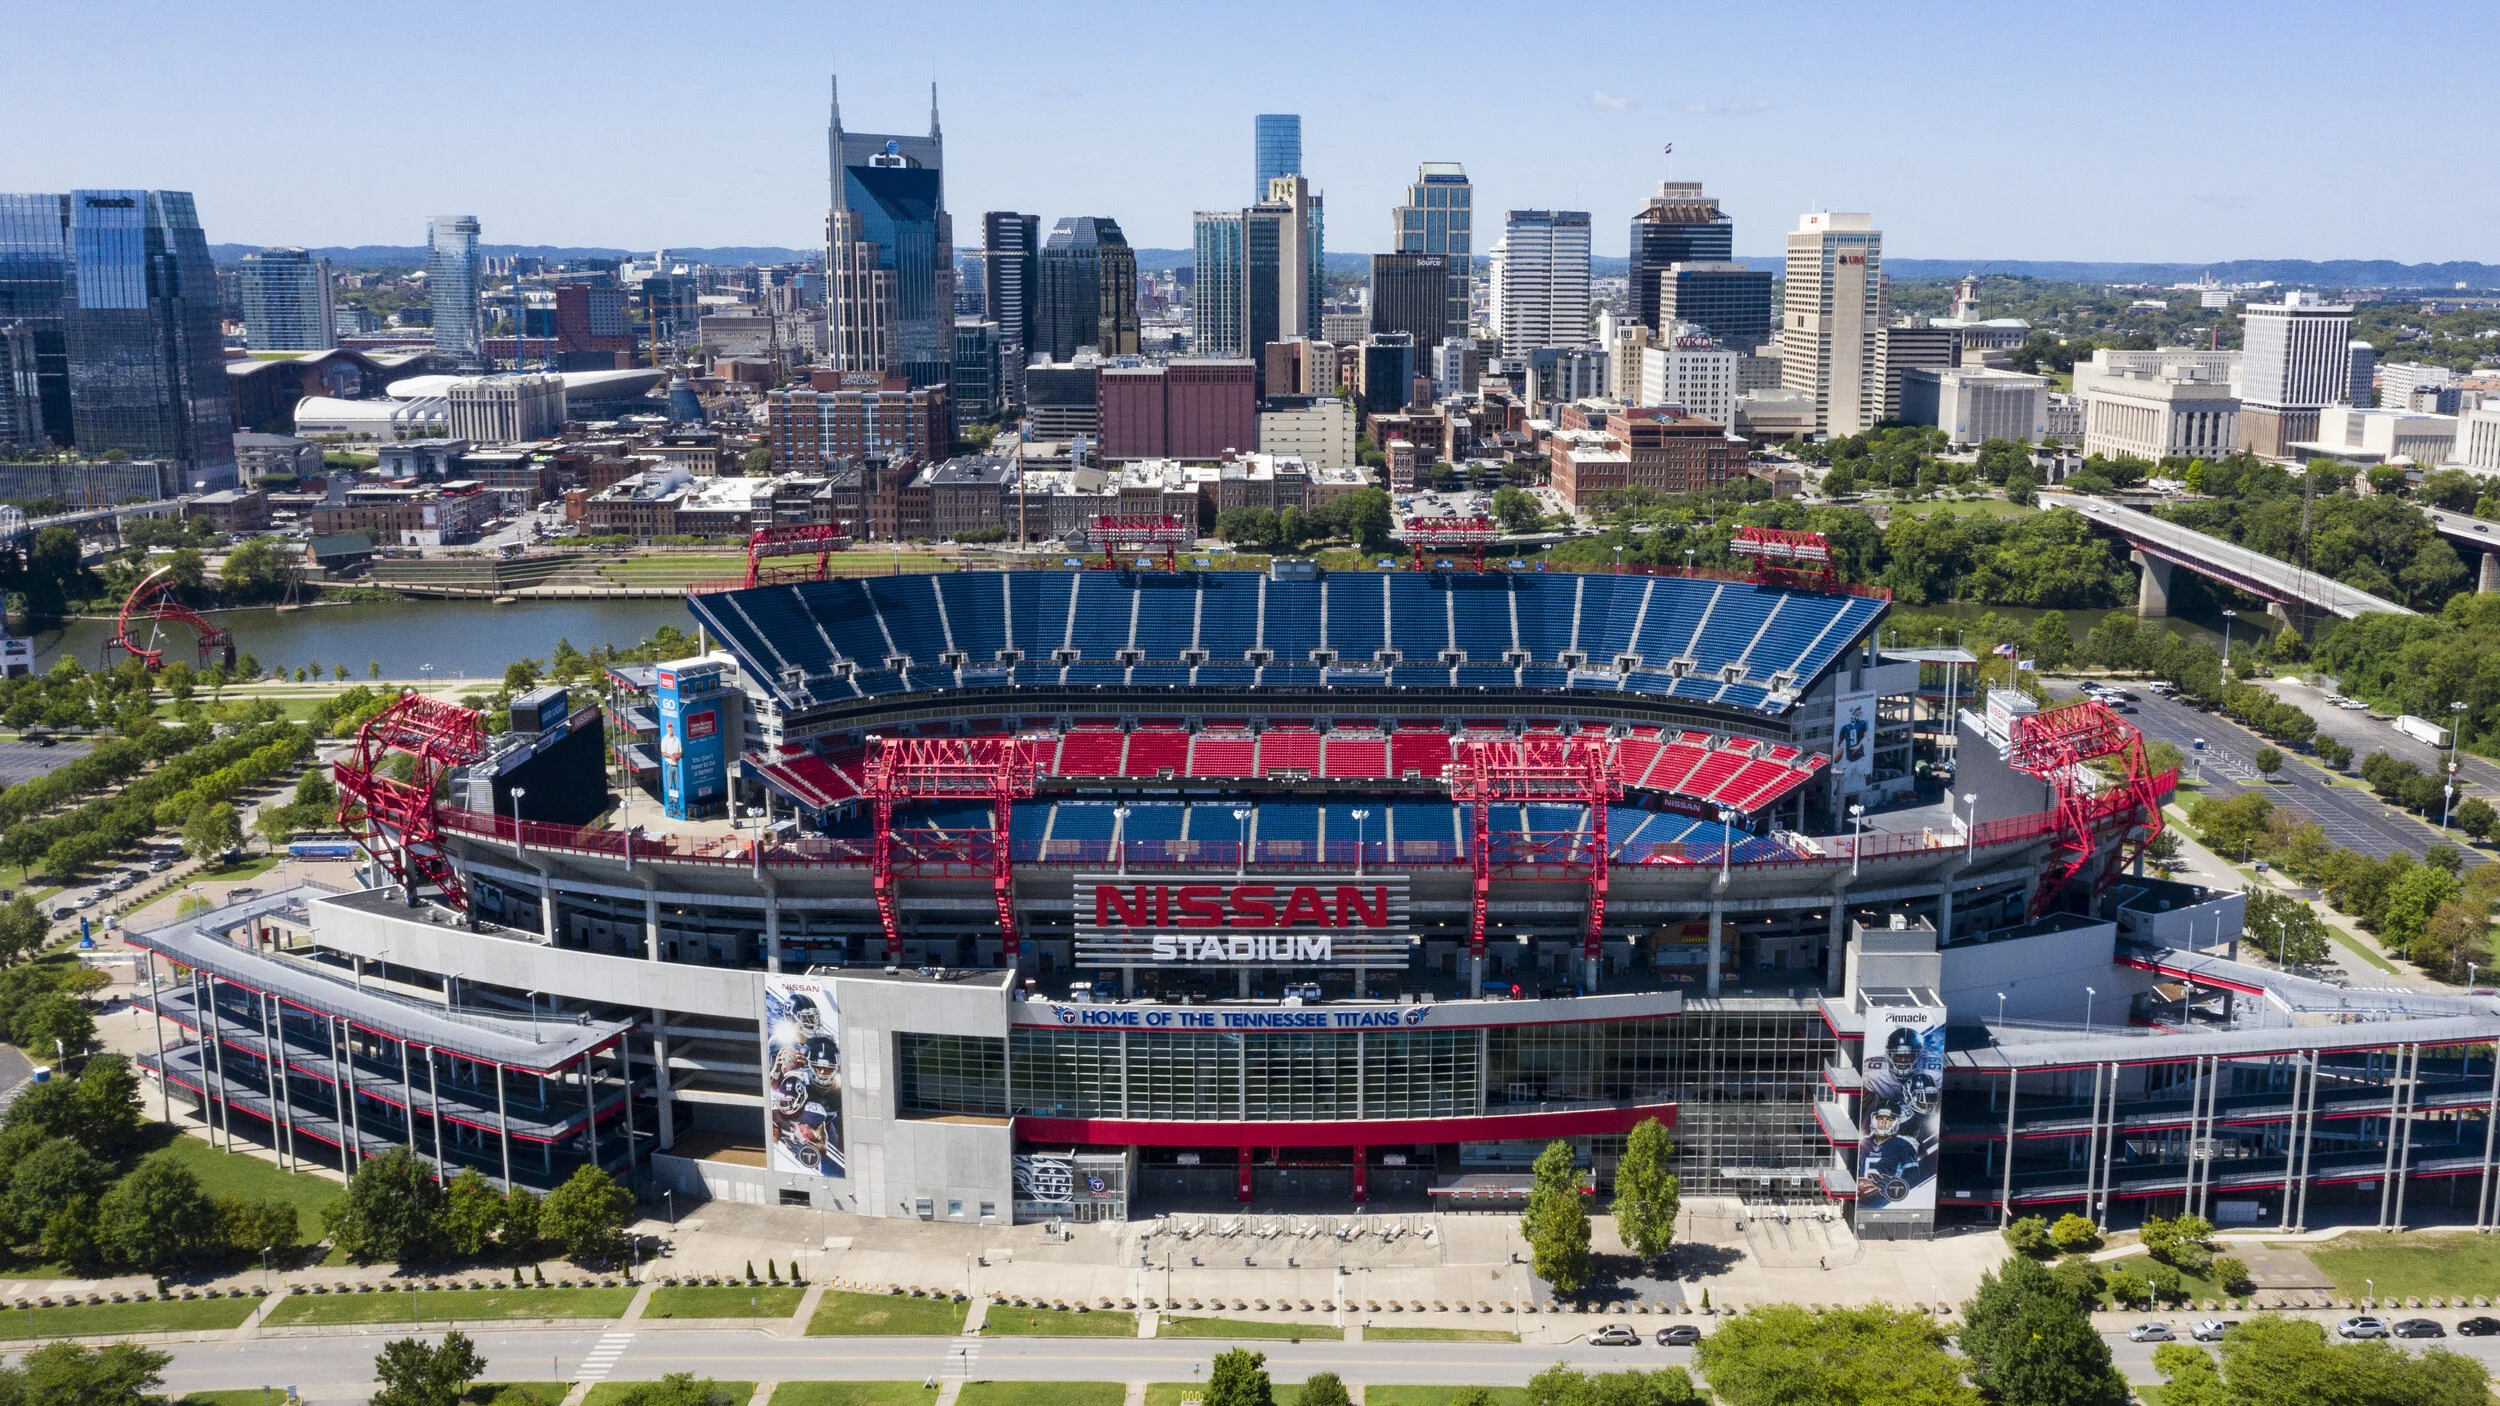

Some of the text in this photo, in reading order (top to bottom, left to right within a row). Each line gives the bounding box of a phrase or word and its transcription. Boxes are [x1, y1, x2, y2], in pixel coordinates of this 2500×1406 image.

[1848, 255, 1865, 265] UBS
[663, 698, 676, 710] GO
[1664, 798, 1701, 812] NISSAN
[1096, 886, 1387, 927] NISSAN
[1152, 936, 1331, 961] STADIUM
[781, 983, 820, 993] NISSAN
[1082, 1011, 1399, 1027] HOME OF THE TENNESSEE TITANS
[1885, 1012, 1928, 1023] Pinnacle
